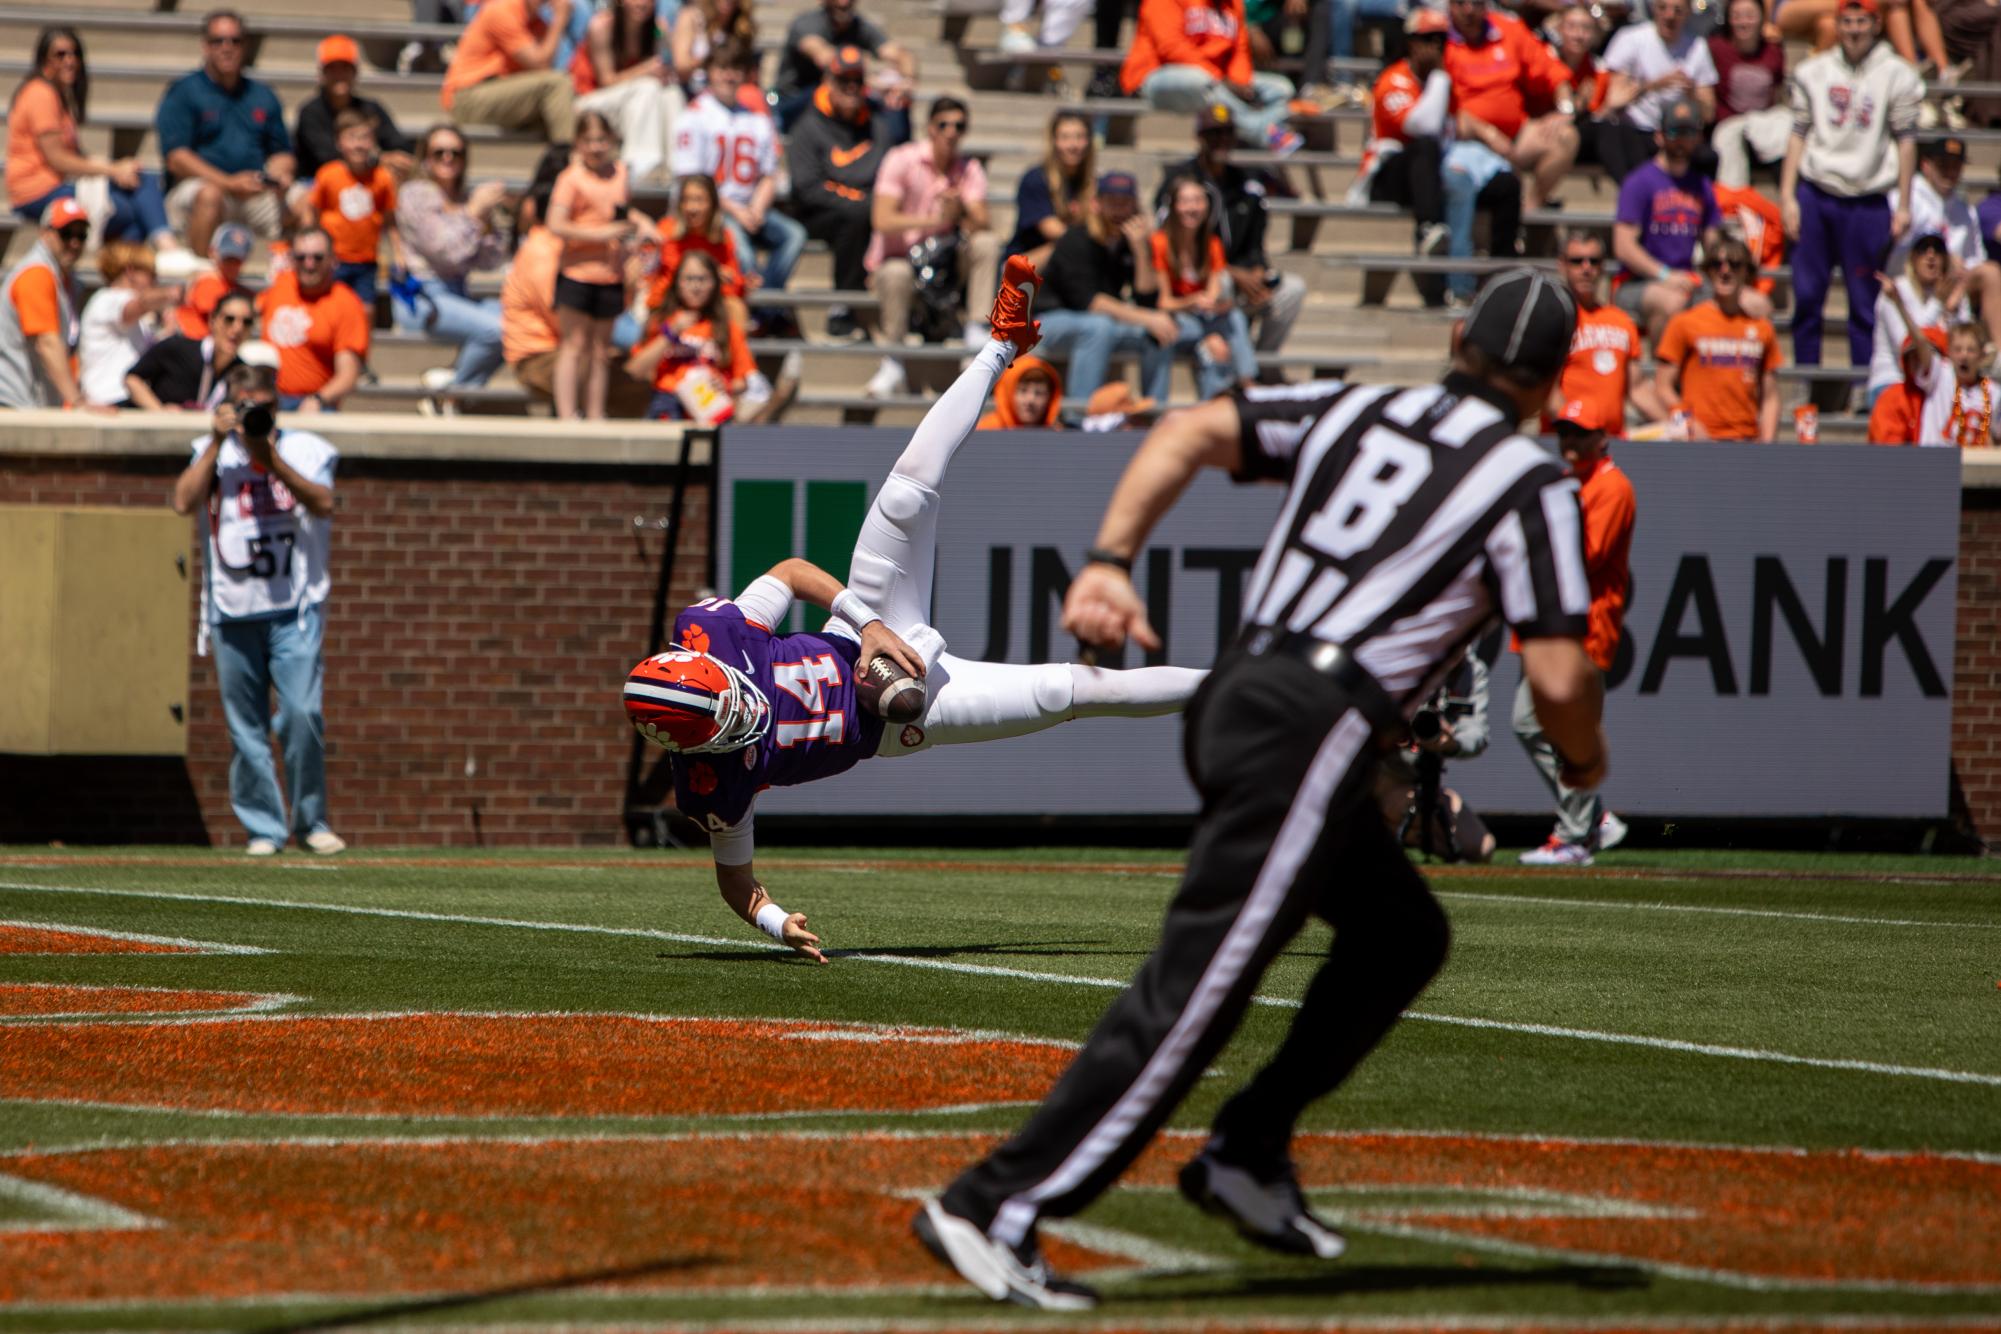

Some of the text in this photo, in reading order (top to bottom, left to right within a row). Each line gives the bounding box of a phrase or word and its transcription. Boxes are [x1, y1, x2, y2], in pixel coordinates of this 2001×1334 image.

[714, 133, 759, 186] 16
[1301, 423, 1434, 560] B
[248, 532, 295, 577] 57
[1604, 553, 1954, 698] ANK
[771, 653, 845, 749] 14
